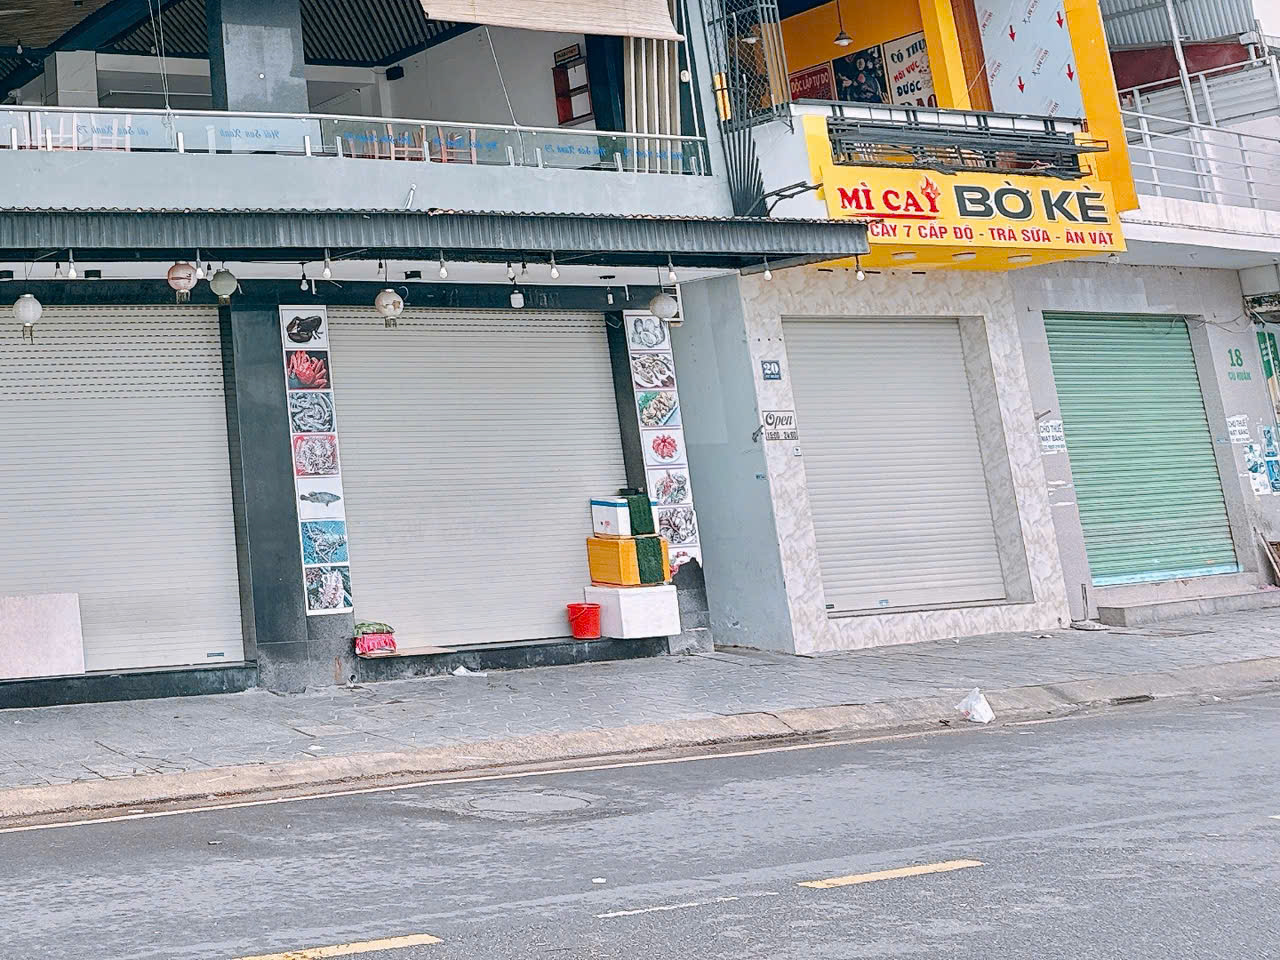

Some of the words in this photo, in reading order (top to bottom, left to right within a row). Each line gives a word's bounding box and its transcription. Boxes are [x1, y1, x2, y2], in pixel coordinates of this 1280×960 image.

[890, 49, 904, 64] CÓ
[837, 182, 874, 211] MÌ
[882, 188, 940, 213] CAY
[953, 180, 1034, 220] BỜ
[1041, 185, 1110, 223] KÈ
[870, 221, 897, 237] CAY
[903, 225, 912, 237] 7
[917, 222, 948, 238] CẤP
[953, 224, 974, 242] ĐỘ
[988, 226, 1017, 241] TRÀ
[1021, 227, 1052, 243] SỮA
[1065, 229, 1086, 244] ĂN
[1088, 230, 1113, 248] VẶT
[1228, 348, 1243, 367] 18
[763, 362, 779, 374] 20
[765, 412, 793, 430] Open
